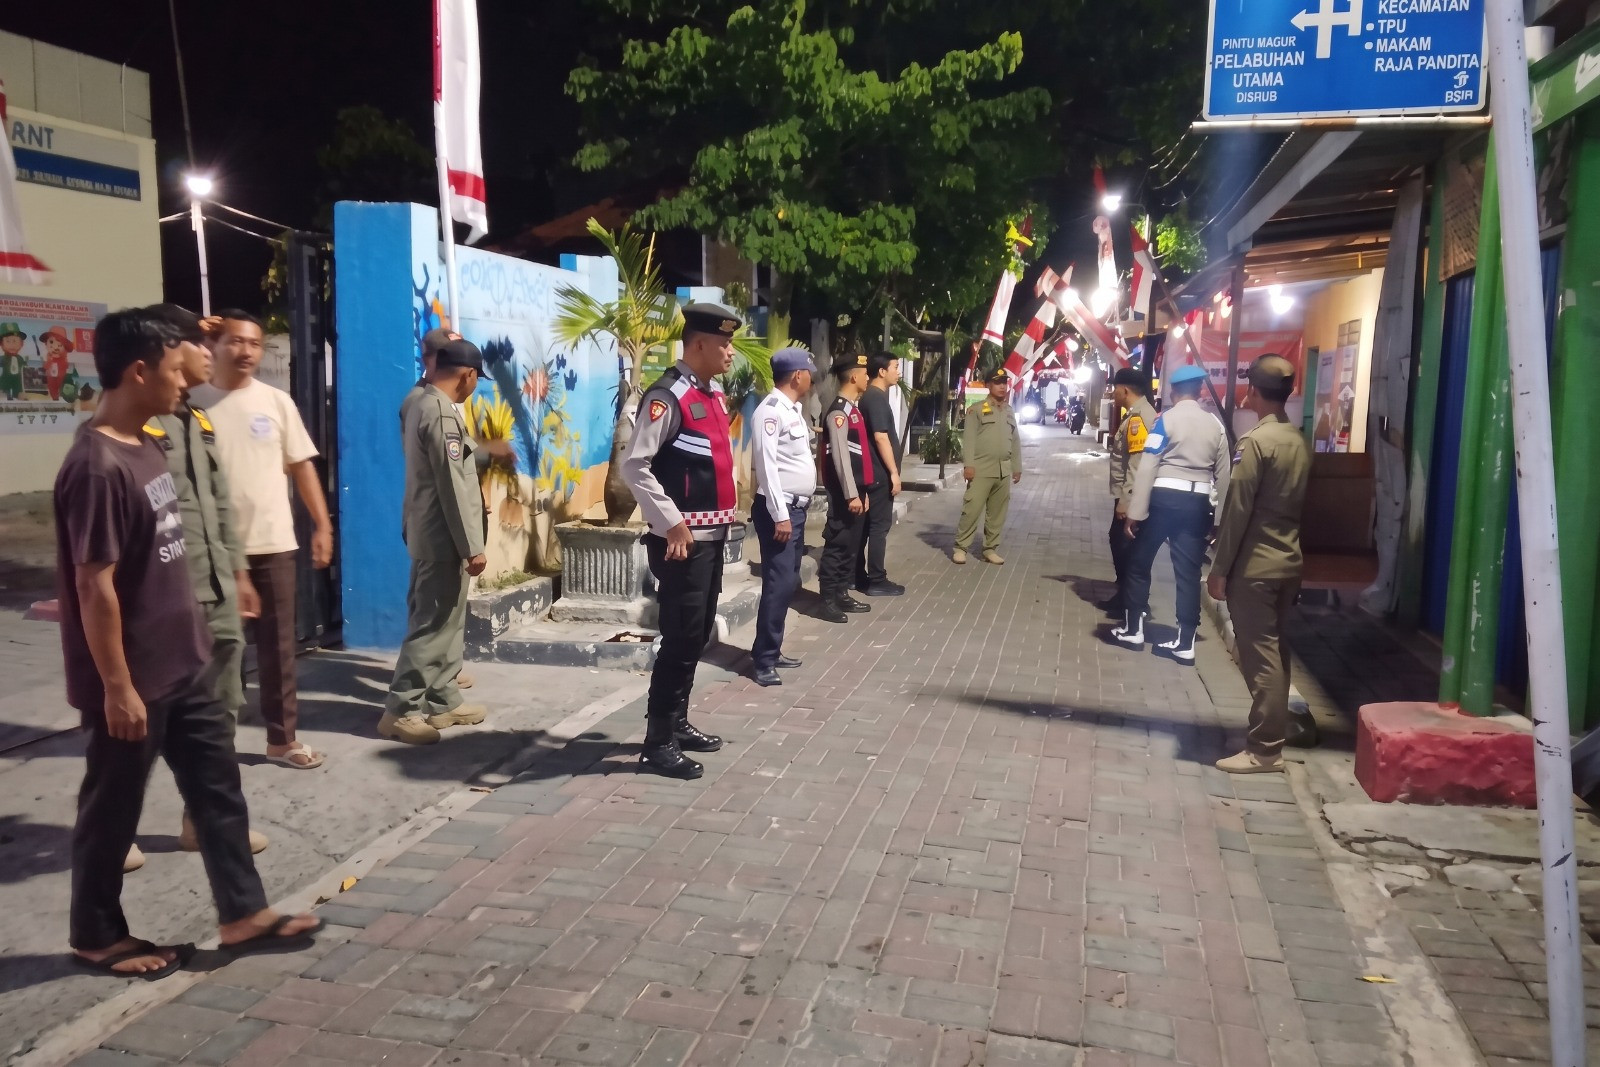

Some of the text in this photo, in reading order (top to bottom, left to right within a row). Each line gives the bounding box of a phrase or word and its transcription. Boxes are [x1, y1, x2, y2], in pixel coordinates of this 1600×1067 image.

[1379, 0, 1470, 14] KECAMATAN
[1378, 19, 1406, 33] TPU
[1222, 36, 1296, 49] PINTU MAGUR
[1376, 36, 1431, 52] MAKAM
[1215, 51, 1305, 69] PELABUHAN
[1375, 54, 1479, 72] RAJA PANDITA
[1233, 71, 1284, 88] UTAMA
[12, 121, 54, 149] RNT
